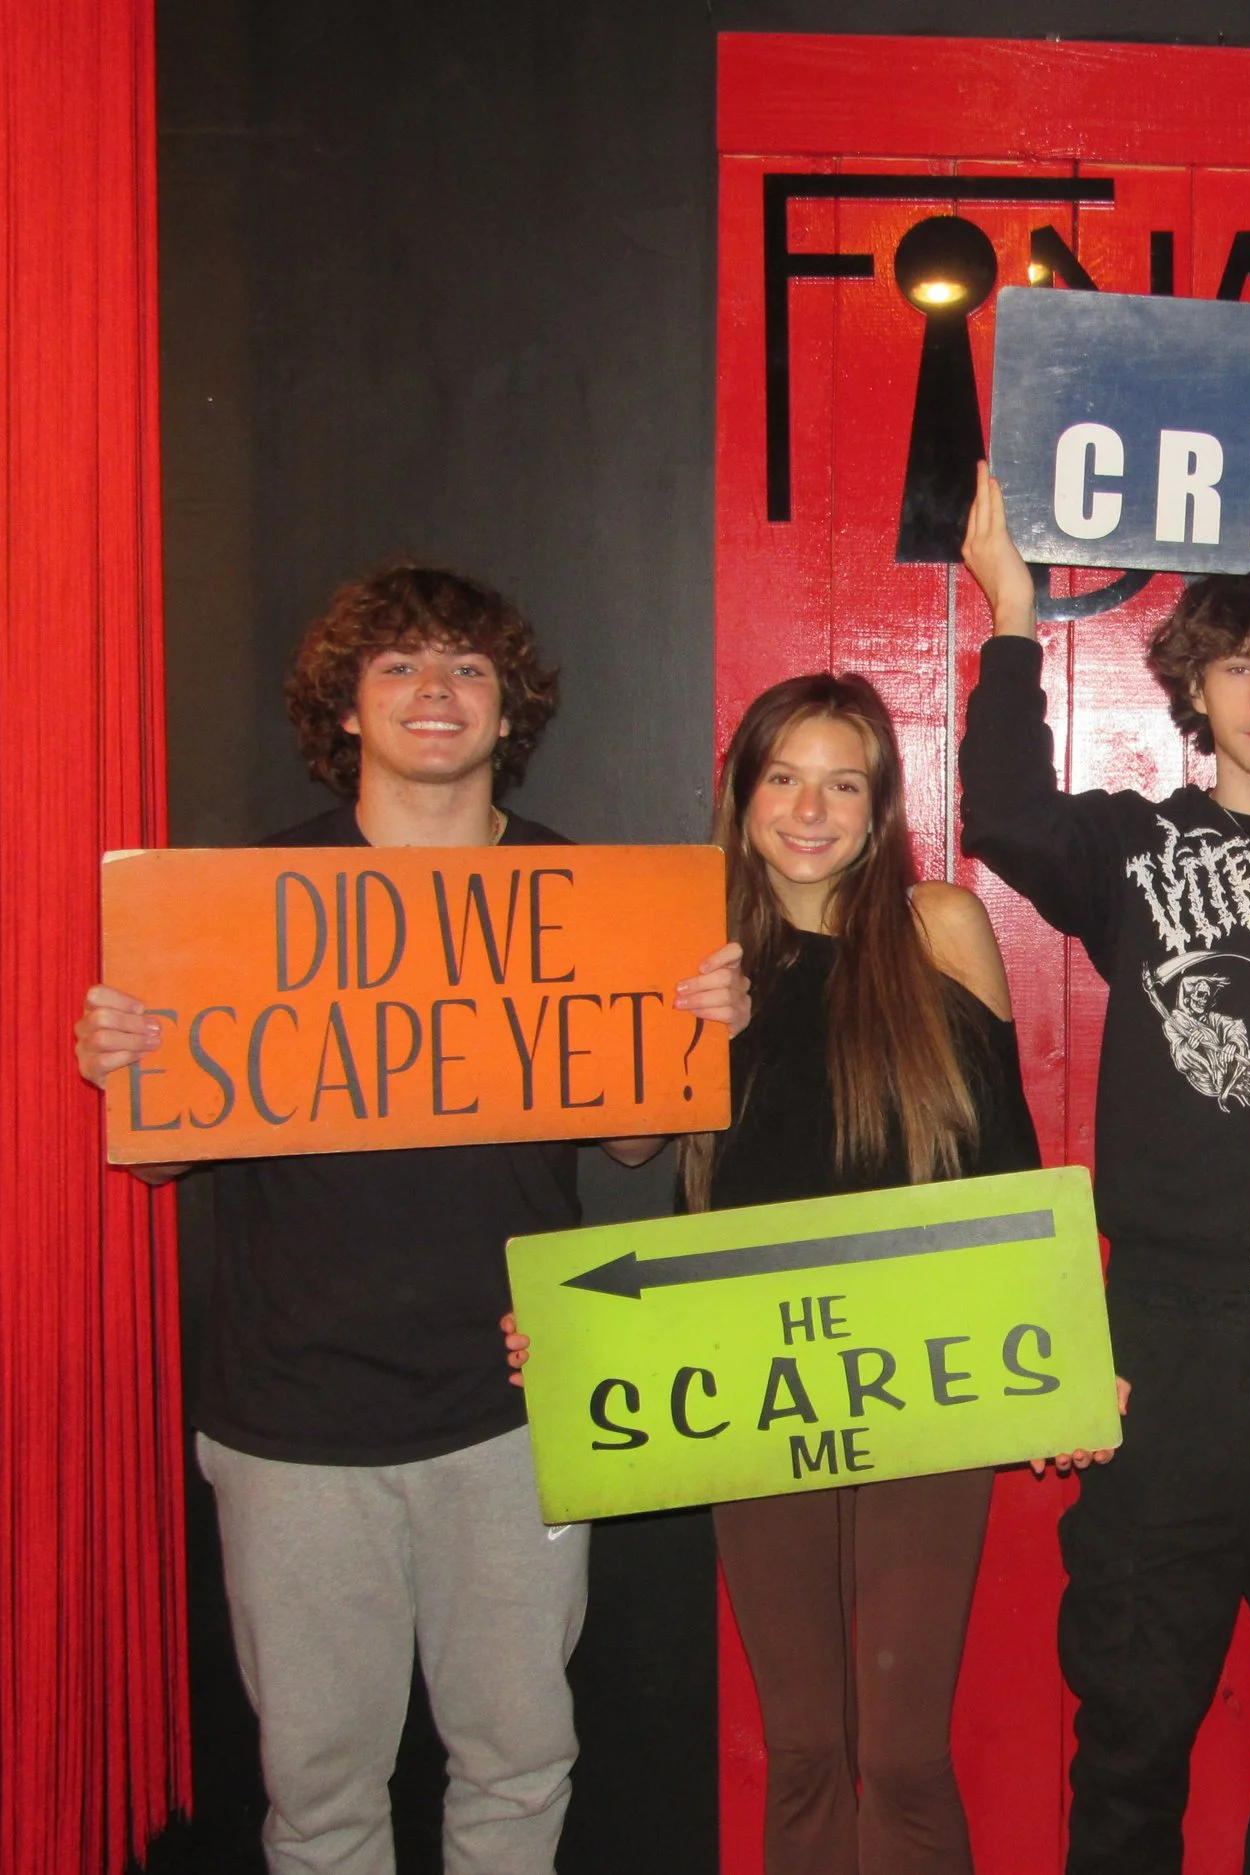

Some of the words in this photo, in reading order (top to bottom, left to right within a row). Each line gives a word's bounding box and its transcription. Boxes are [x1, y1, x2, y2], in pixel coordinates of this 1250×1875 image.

[275, 870, 407, 992] DID
[432, 869, 577, 988] WE
[127, 999, 480, 1132] ESCAPE
[779, 1295, 852, 1345] HE
[590, 1324, 1062, 1451] SCARES
[789, 1428, 875, 1480] ME
